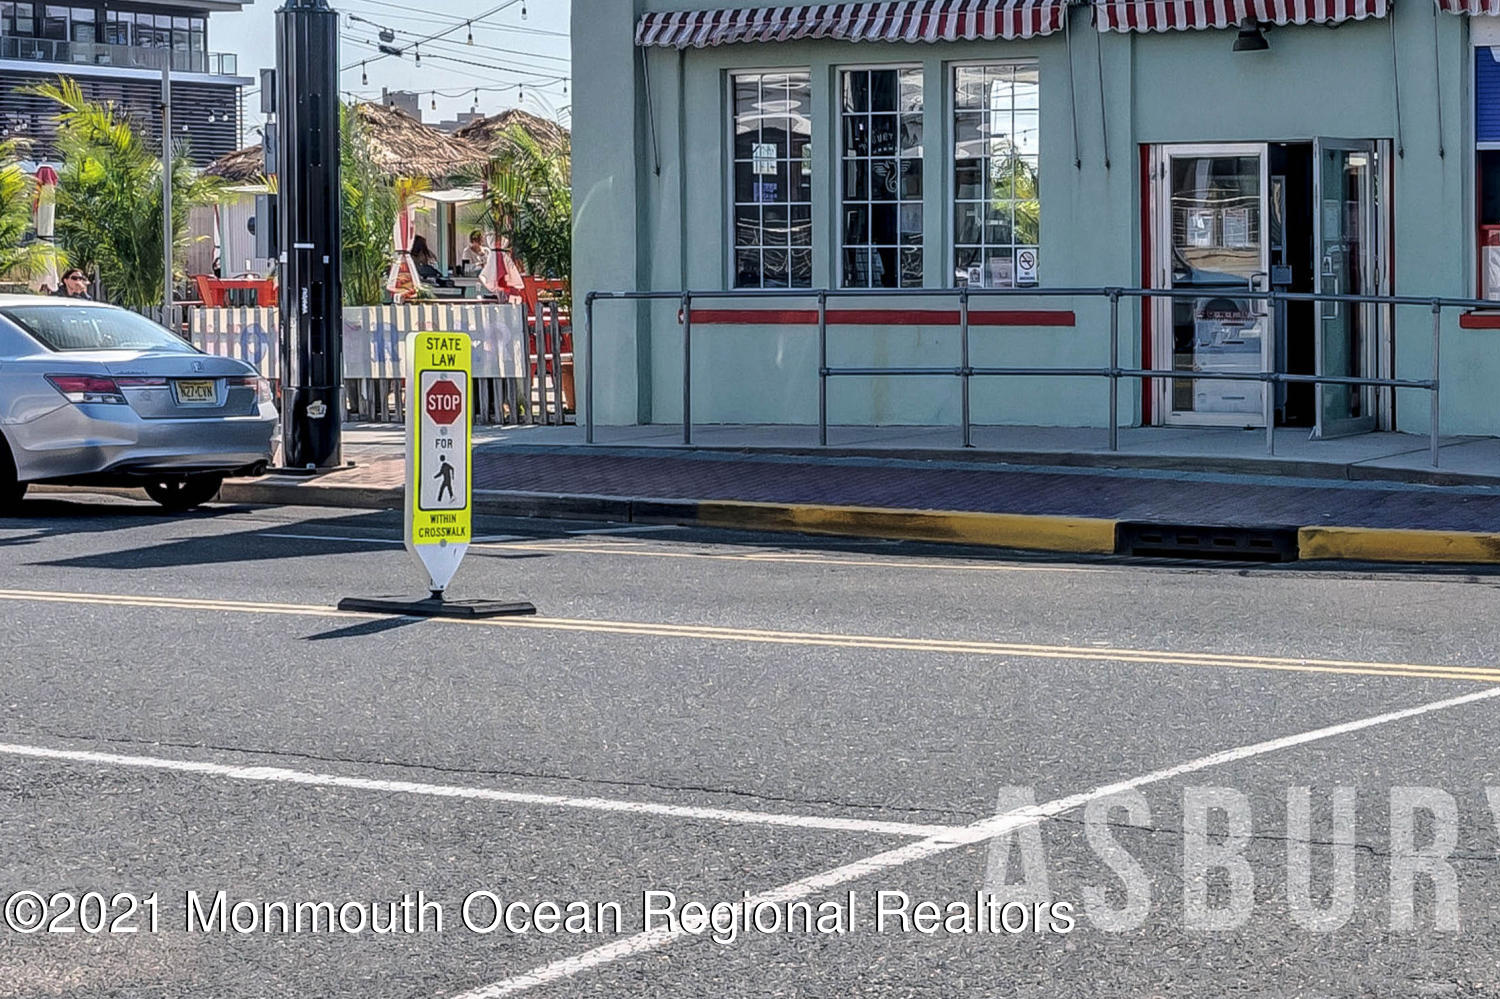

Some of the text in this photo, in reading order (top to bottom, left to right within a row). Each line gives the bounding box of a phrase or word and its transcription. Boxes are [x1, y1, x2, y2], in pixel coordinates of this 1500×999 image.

[426, 337, 461, 351] STATE
[431, 353, 456, 367] LAW
[428, 394, 460, 411] STOP
[435, 438, 453, 449] FOR
[430, 514, 457, 524] WITHIN
[418, 527, 466, 538] CROSSWALK
